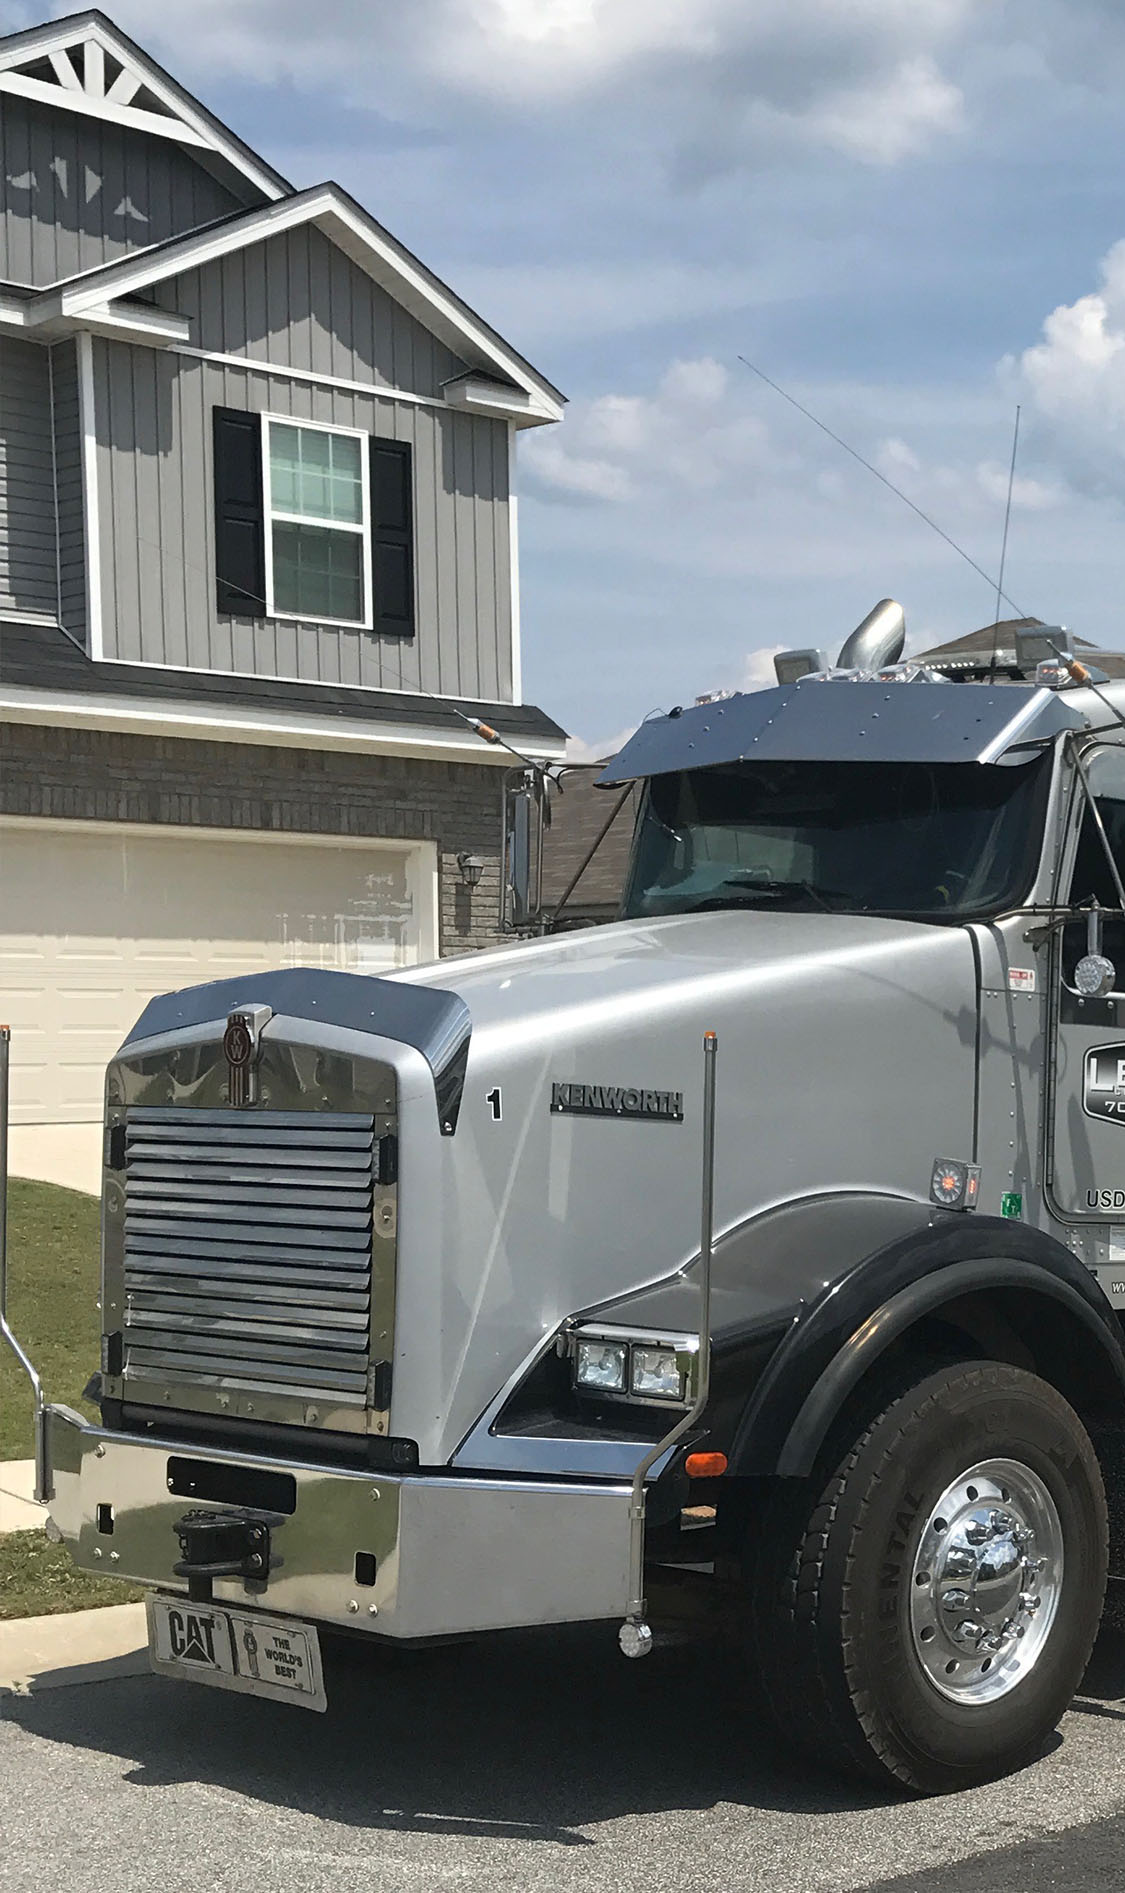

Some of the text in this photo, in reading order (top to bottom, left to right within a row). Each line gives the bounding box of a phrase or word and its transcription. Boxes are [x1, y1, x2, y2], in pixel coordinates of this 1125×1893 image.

[484, 1086, 502, 1121] 1
[552, 1083, 684, 1113] KENWORTH
[169, 1610, 216, 1663] CAT
[272, 1636, 291, 1651] THE
[264, 1647, 304, 1668] WORLD'S
[274, 1664, 297, 1680] BEST
